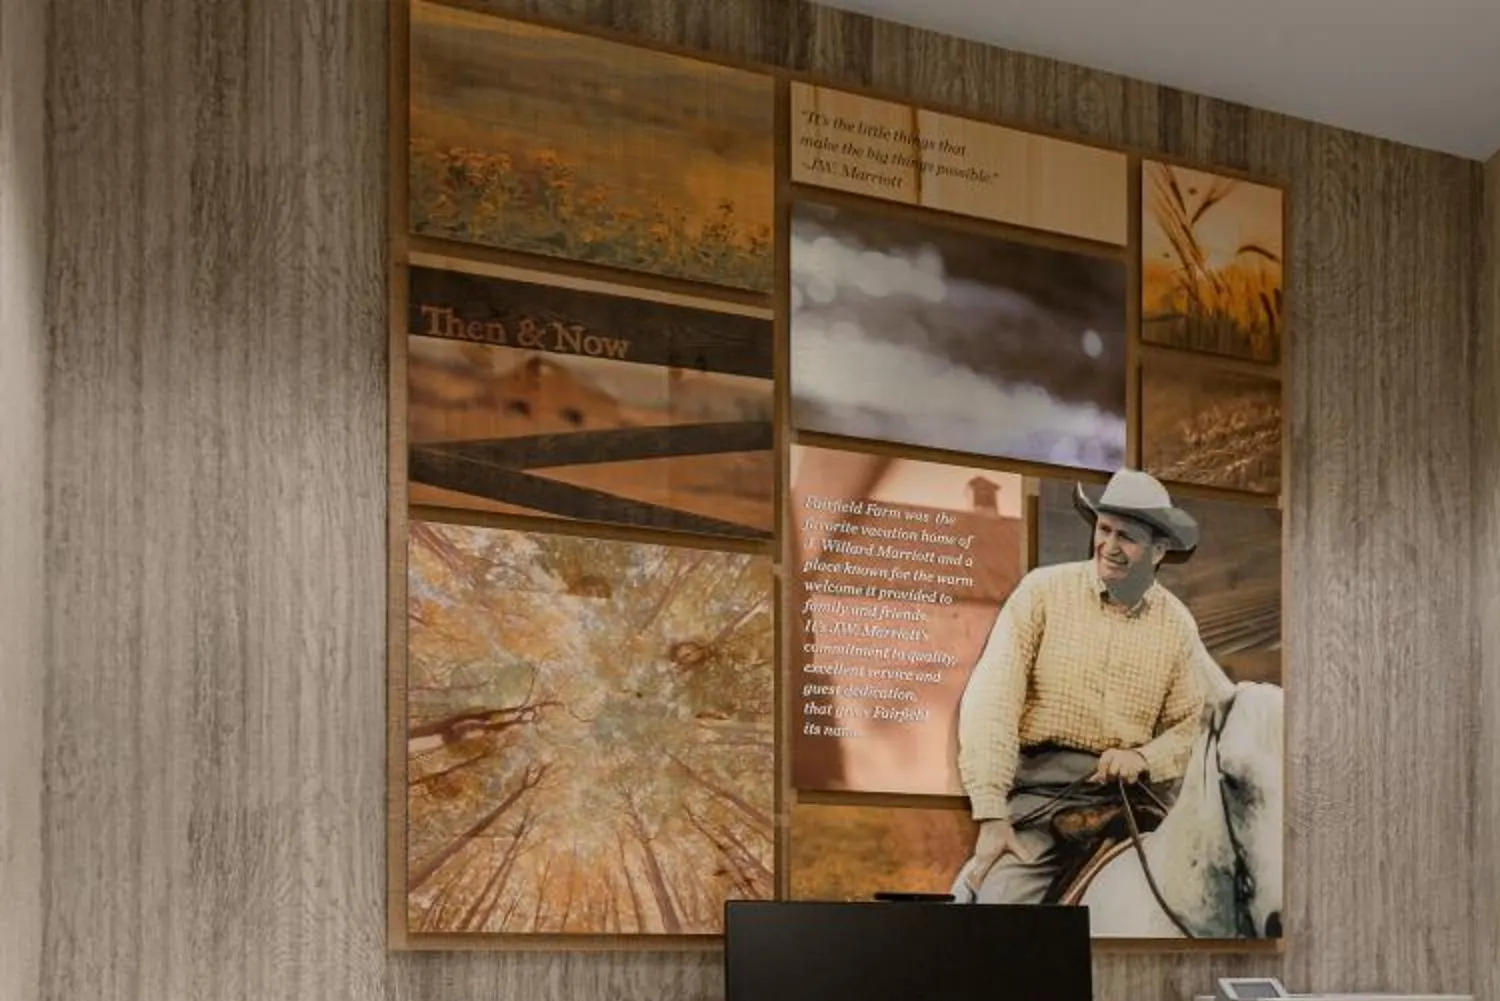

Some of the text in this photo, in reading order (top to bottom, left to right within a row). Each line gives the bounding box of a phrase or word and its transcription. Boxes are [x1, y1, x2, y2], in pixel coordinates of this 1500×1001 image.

[833, 116, 855, 132] the
[857, 121, 891, 141] little
[939, 138, 967, 156] that
[800, 135, 839, 152] make
[842, 143, 864, 158] the
[867, 147, 889, 164] big
[841, 164, 904, 189] Marriott
[421, 304, 632, 359] Then & Now
[805, 495, 956, 525] Fairfield Farm was the
[802, 517, 976, 550] favorite vacation home of
[822, 538, 873, 557] Willard
[876, 545, 935, 564] Marriott
[938, 553, 963, 566] and
[803, 559, 973, 587] place known for the warm
[804, 580, 864, 596] welcome
[878, 584, 937, 604] provided
[940, 593, 953, 606] to
[802, 600, 849, 618] family
[851, 605, 876, 618] and
[804, 643, 890, 660] commitment
[892, 649, 905, 660] to
[804, 663, 942, 683] excellent service and
[803, 684, 841, 697] guest
[804, 701, 832, 715] that
[804, 724, 820, 736] its
